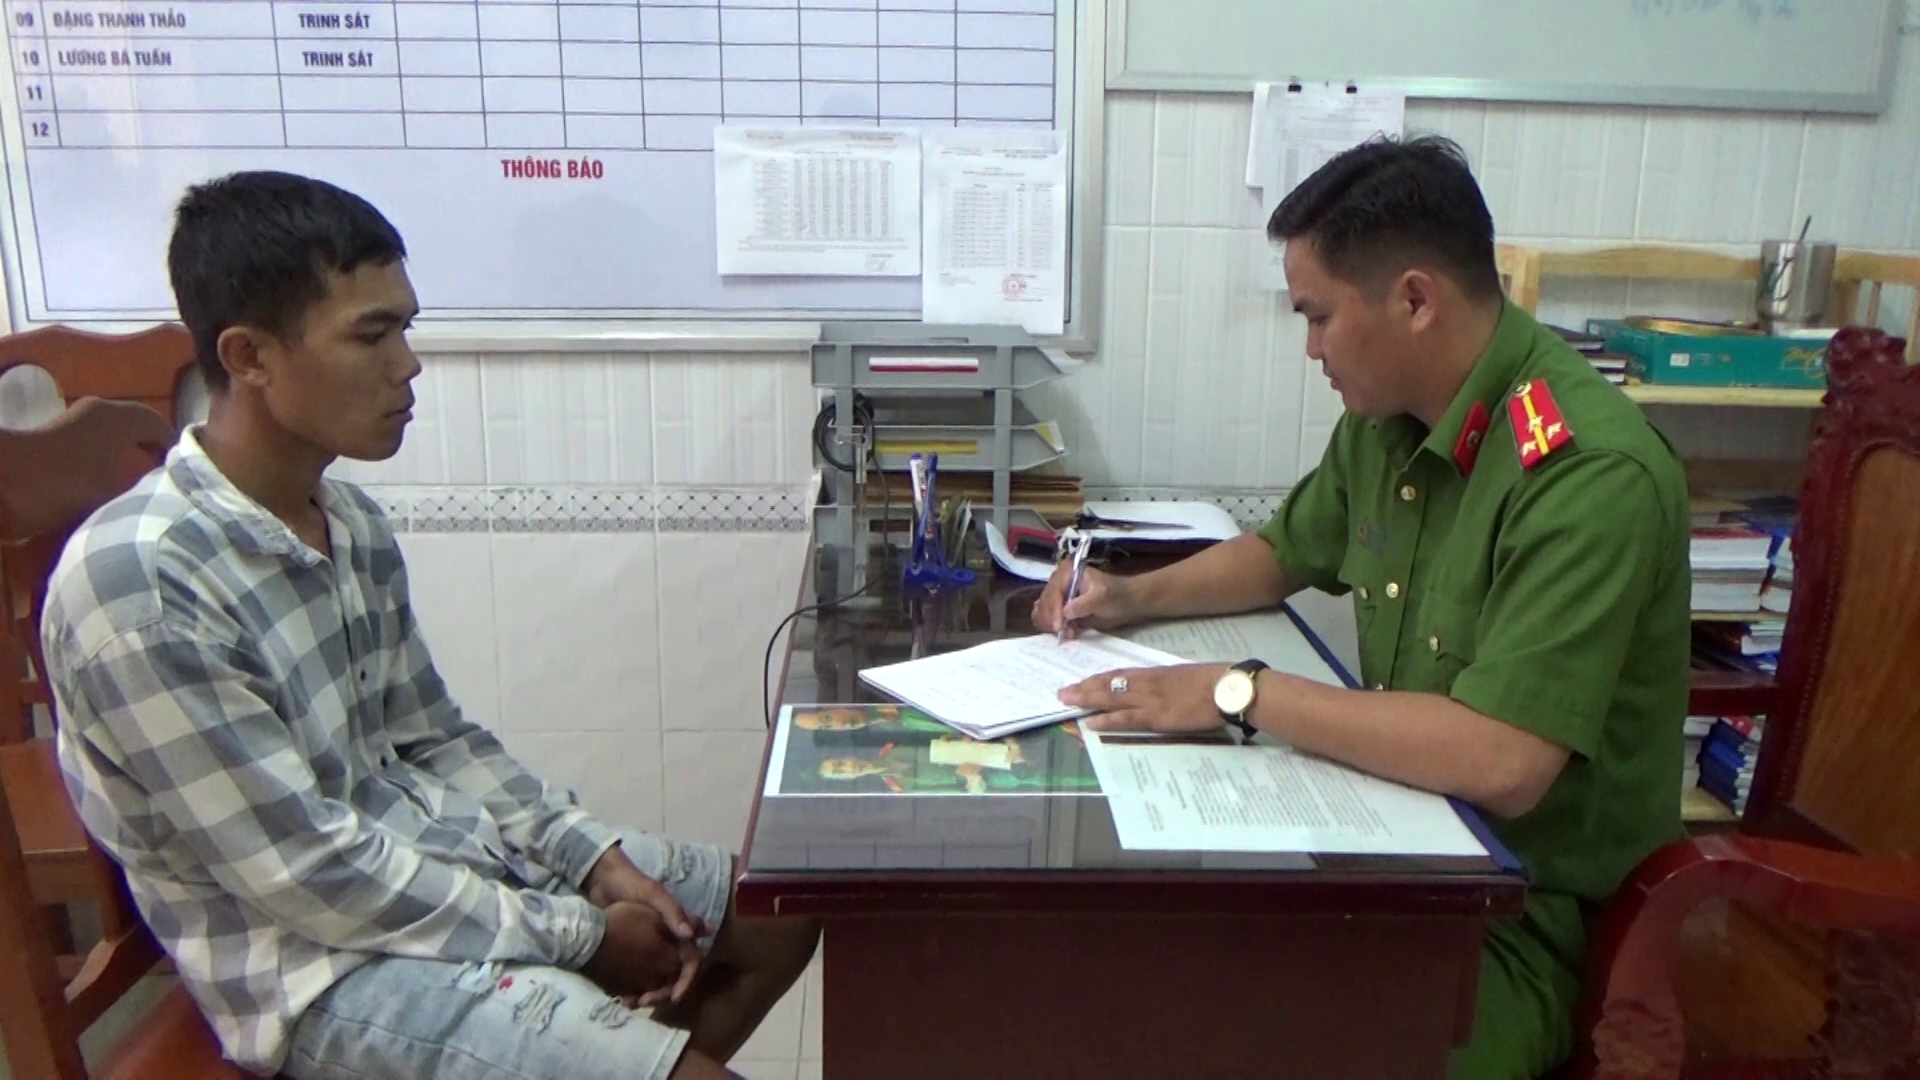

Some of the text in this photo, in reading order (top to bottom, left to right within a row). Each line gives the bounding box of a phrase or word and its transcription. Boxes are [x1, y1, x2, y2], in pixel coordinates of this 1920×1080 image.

[15, 12, 34, 28] 09
[98, 12, 146, 28] THANH
[298, 10, 370, 29] TRINH SÁT
[22, 51, 40, 66] 10
[111, 48, 131, 66] BÁ
[302, 49, 374, 67] TRINH SÁT
[26, 85, 42, 100] 11
[32, 121, 50, 137] 12
[500, 155, 604, 178] THÔNG BÁO
